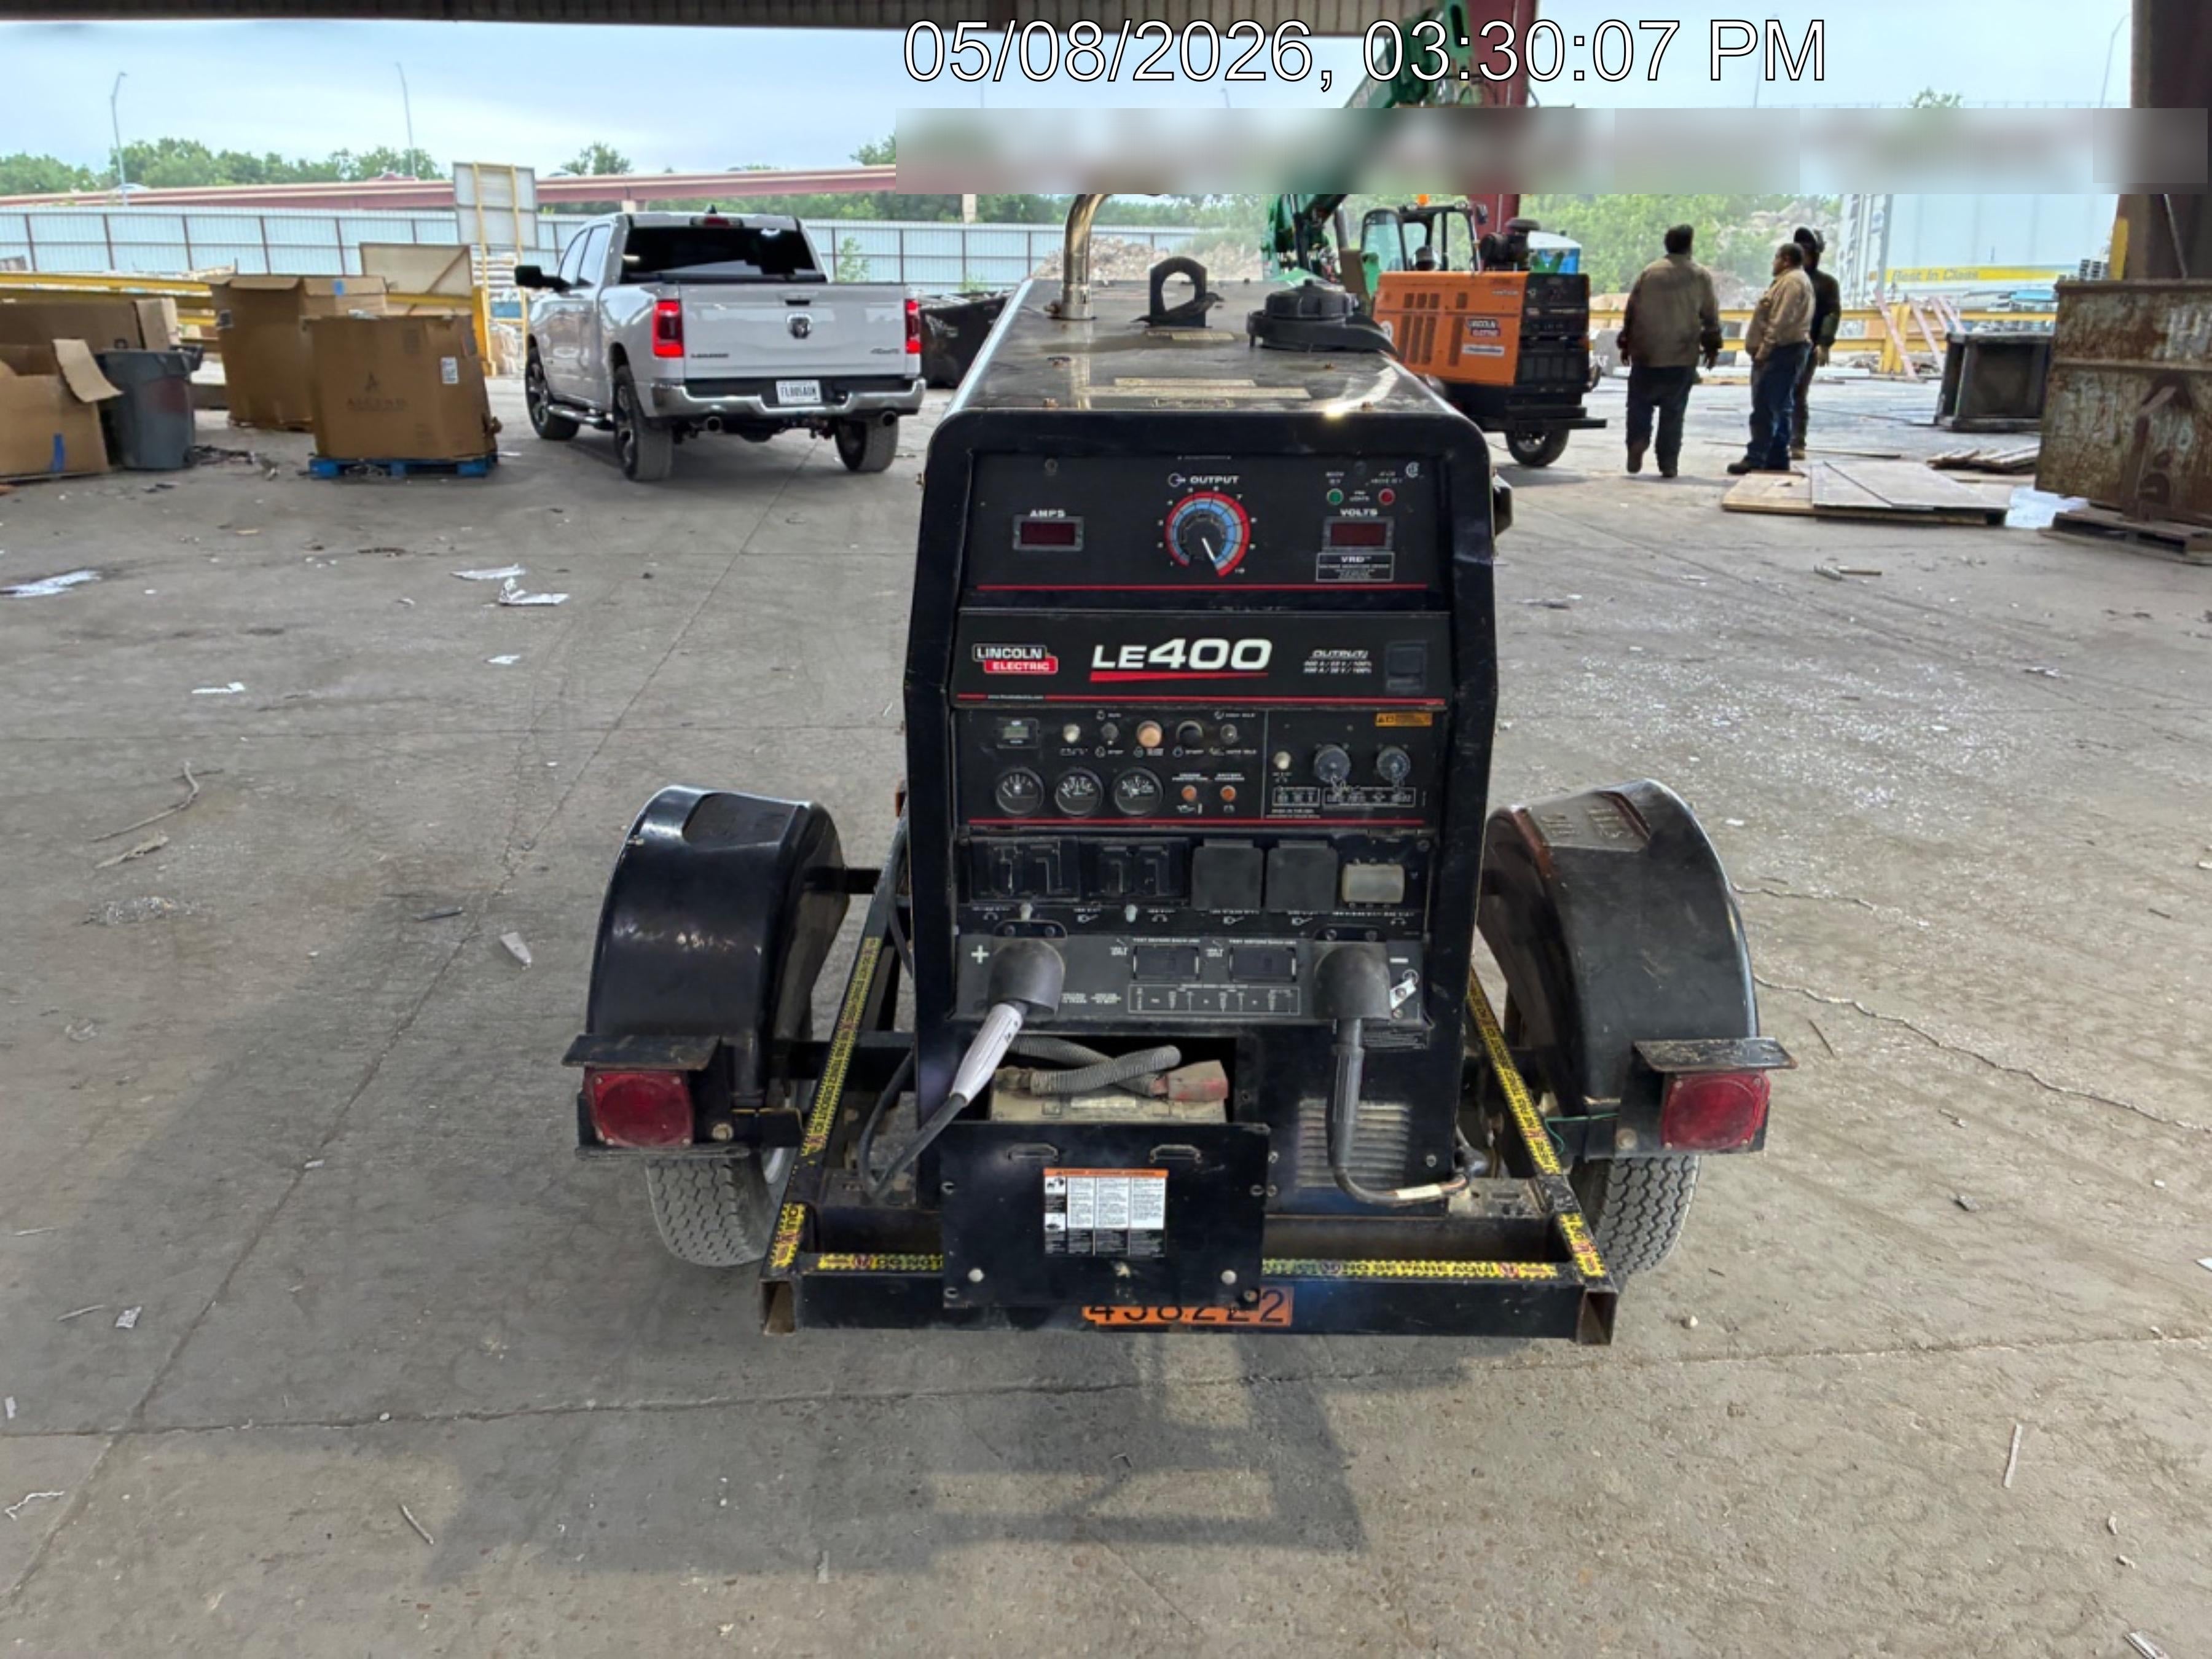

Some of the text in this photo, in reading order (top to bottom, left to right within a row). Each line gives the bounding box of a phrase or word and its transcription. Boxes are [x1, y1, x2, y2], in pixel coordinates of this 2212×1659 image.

[976, 648, 1043, 659] LINCOLN
[1092, 638, 1273, 669] LE400
[992, 661, 1049, 670] ELECTRIC
